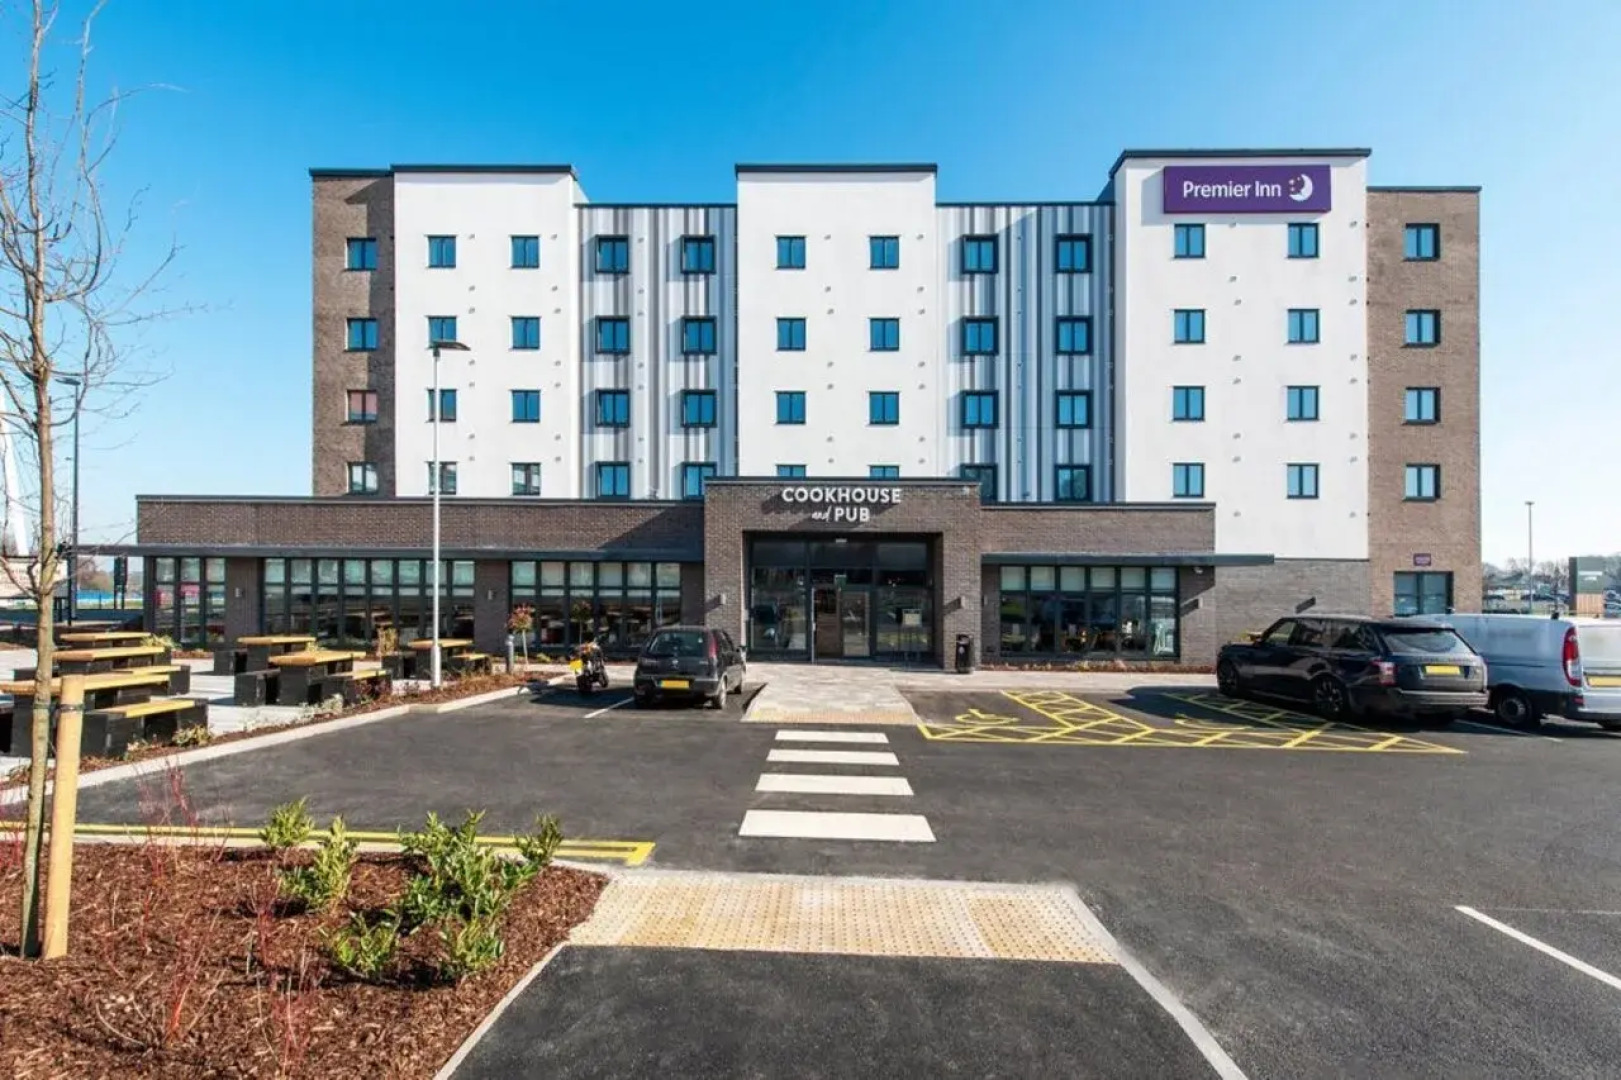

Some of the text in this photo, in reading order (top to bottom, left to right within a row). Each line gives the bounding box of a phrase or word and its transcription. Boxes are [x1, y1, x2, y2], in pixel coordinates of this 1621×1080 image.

[1183, 180, 1282, 198] Premier Inn
[781, 487, 902, 503] COOKHOUSE
[811, 506, 870, 522] and PUB
